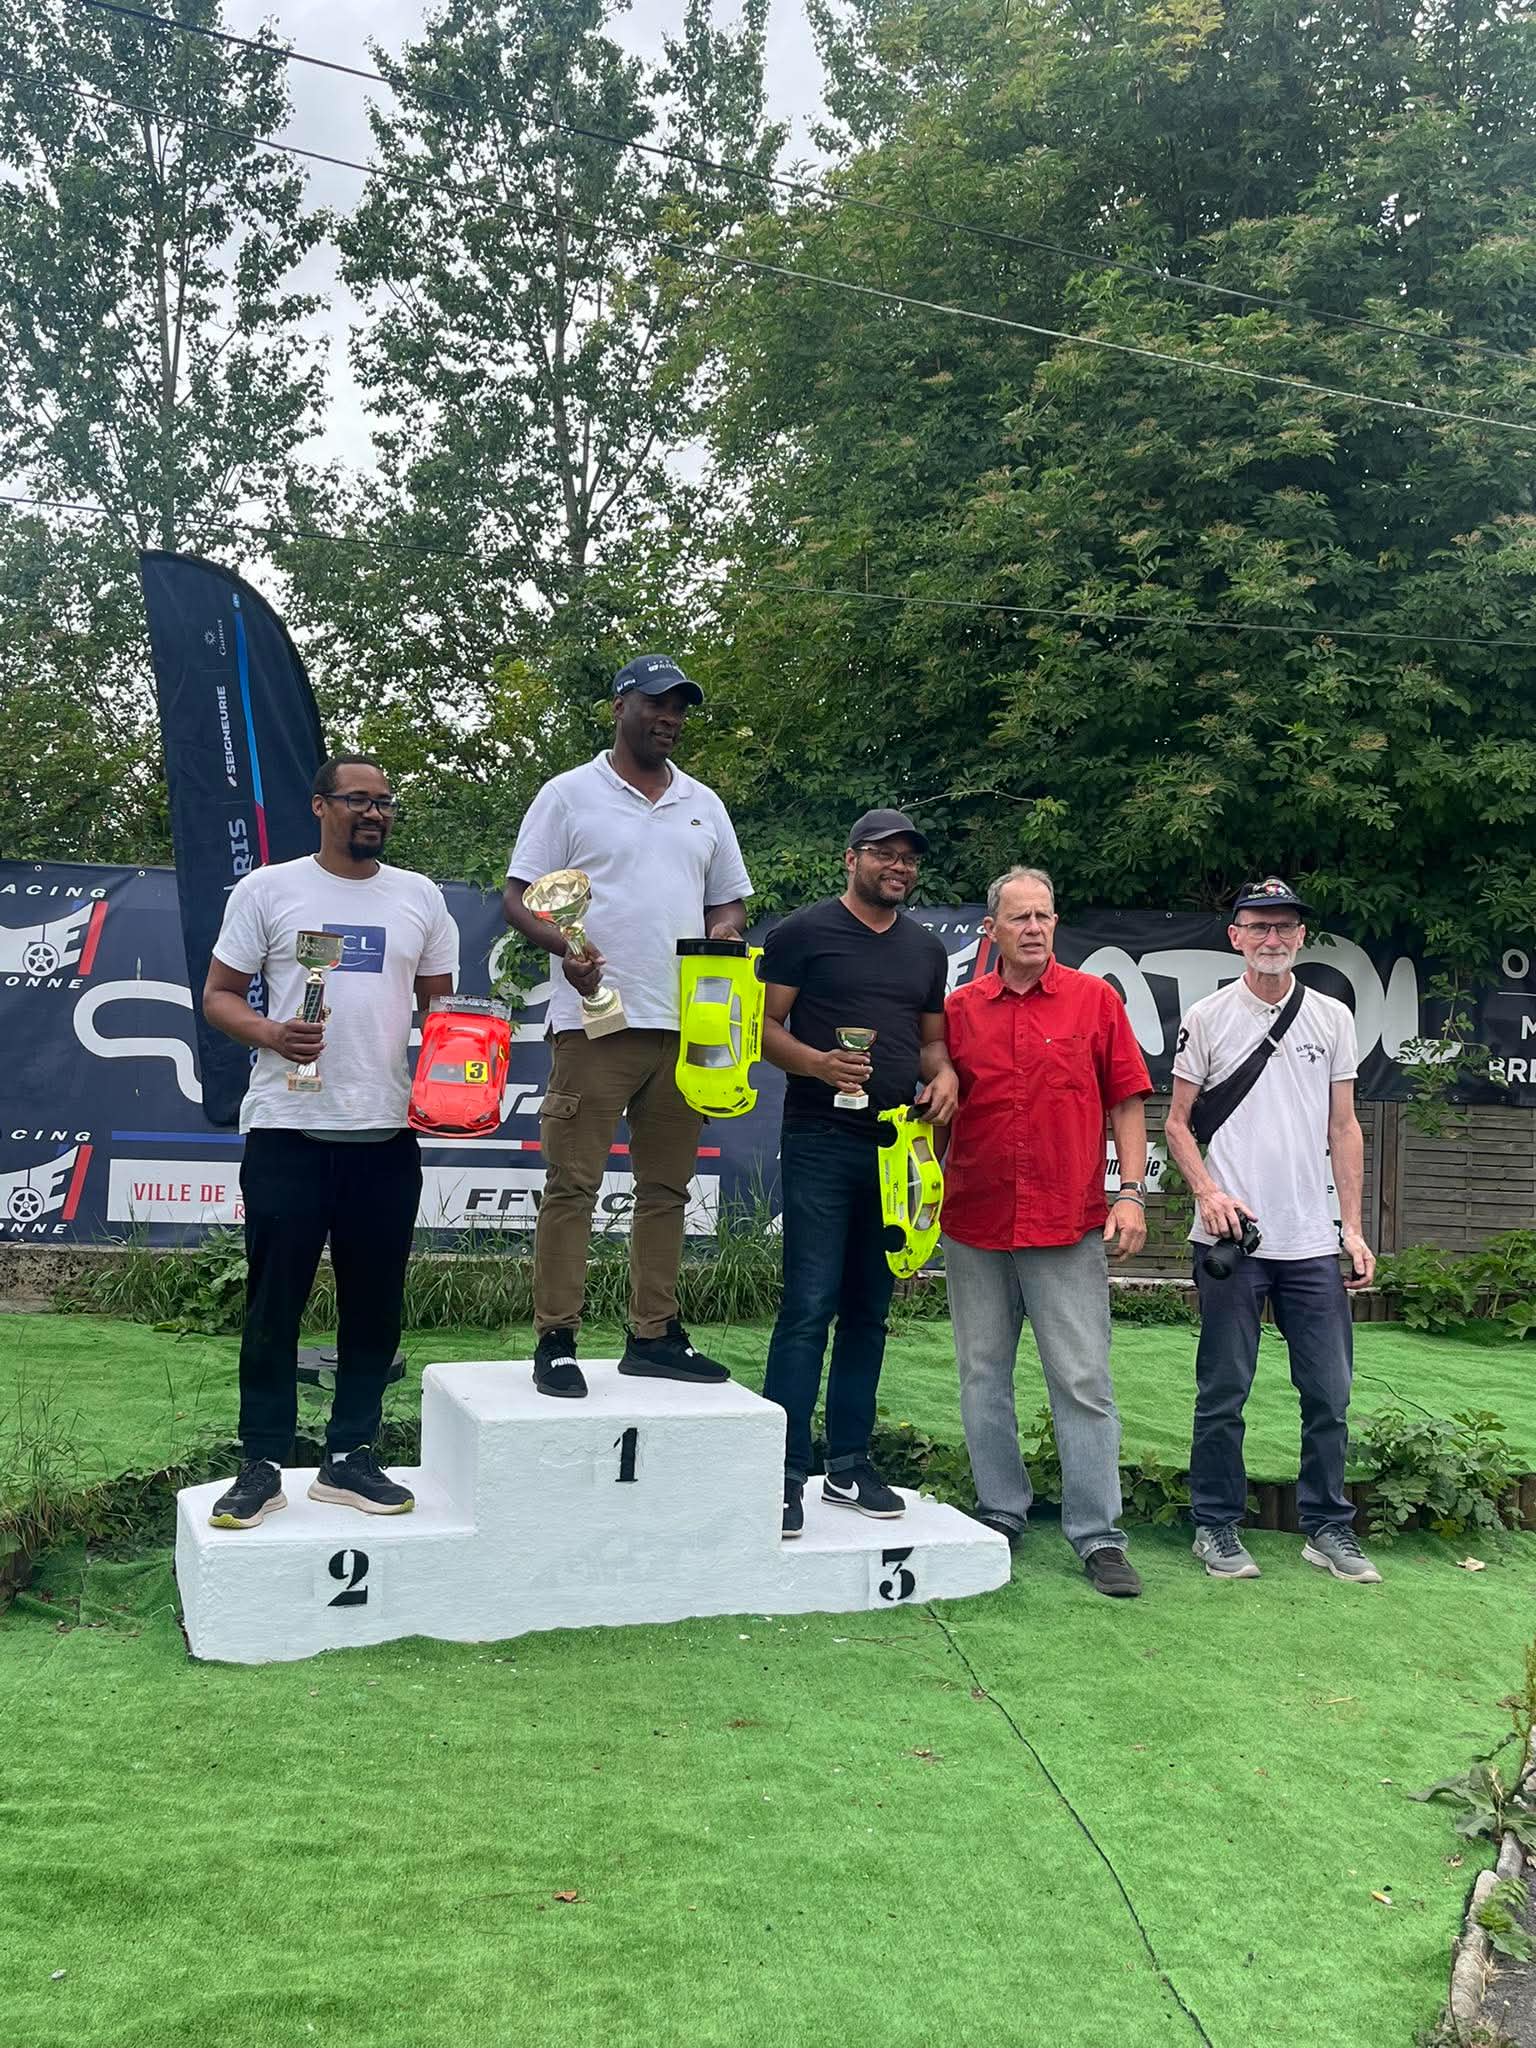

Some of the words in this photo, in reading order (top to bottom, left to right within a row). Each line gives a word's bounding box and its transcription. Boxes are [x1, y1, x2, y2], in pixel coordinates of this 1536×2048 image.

[216, 686, 236, 775] SEIGNEURIE
[227, 818, 251, 878] RIS
[0, 884, 106, 899] ACING
[342, 935, 377, 951] CL
[5, 976, 83, 989] ONNE
[469, 1062, 485, 1079] 3
[10, 1129, 91, 1141] CING
[133, 1183, 192, 1202] VILLE
[200, 1184, 226, 1203] DE
[465, 1188, 636, 1214] FFC
[613, 1427, 639, 1483] 1
[327, 1549, 369, 1607] 2
[879, 1546, 916, 1601] 3
